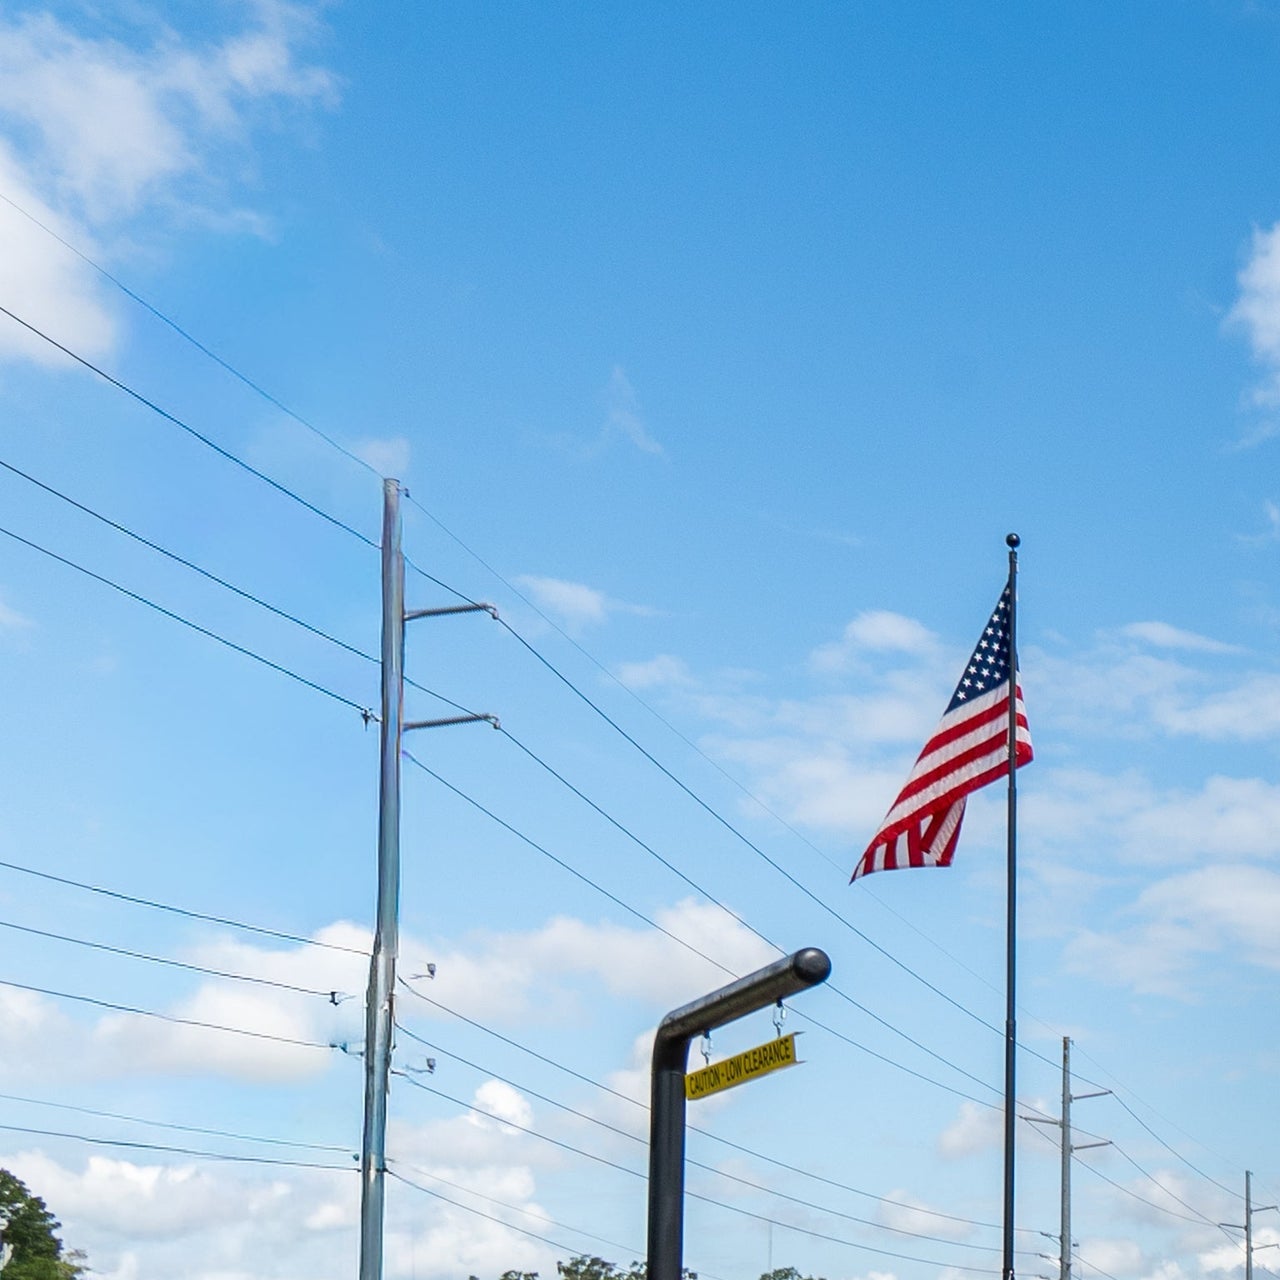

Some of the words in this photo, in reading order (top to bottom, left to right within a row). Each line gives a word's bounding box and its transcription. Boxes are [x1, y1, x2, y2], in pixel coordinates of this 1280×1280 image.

[689, 1068, 721, 1094] CAUTION
[726, 1058, 743, 1082] LOW
[744, 1038, 792, 1075] CLEARANCE
